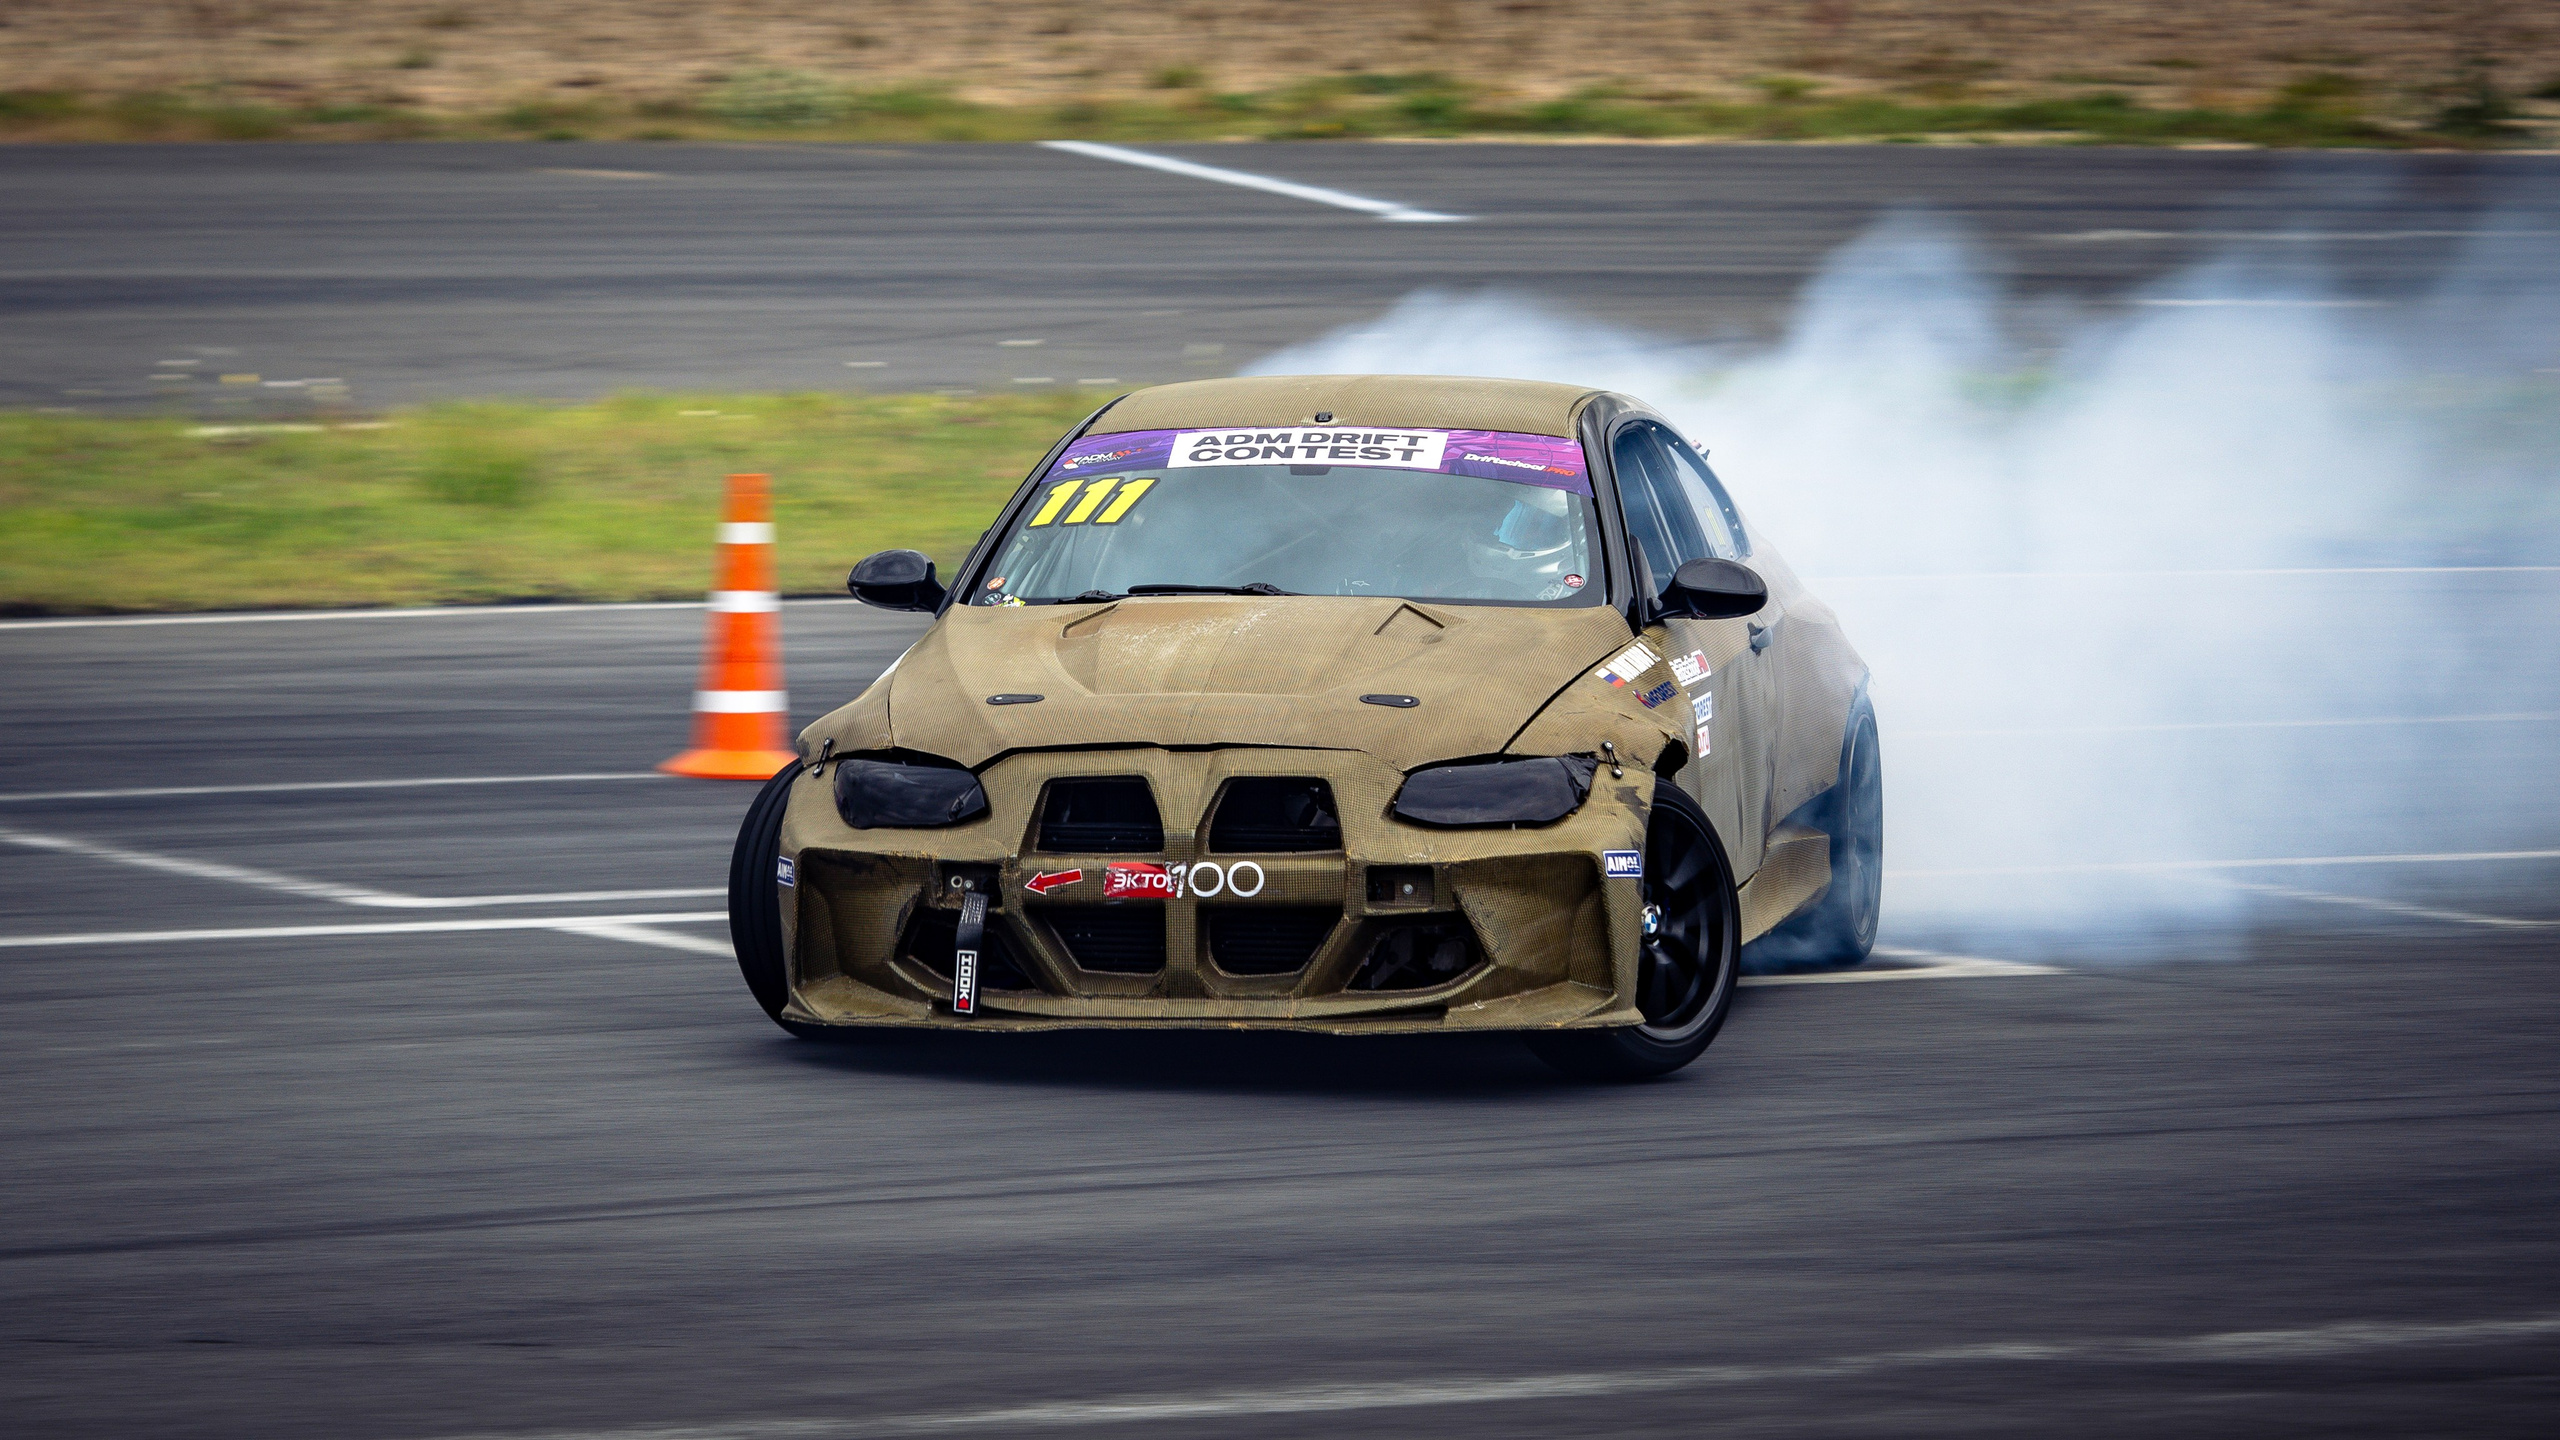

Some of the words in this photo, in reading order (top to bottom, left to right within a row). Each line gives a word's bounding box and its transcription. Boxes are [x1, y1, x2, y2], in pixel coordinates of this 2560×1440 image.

[1188, 445, 1425, 462] CONTEST
[1193, 434, 1292, 447] ADM
[1301, 433, 1428, 446] DRIFT
[1080, 452, 1114, 461] ADM
[1027, 478, 1158, 529] 111
[1171, 861, 1265, 899] 100
[959, 955, 973, 1000] HOOK
